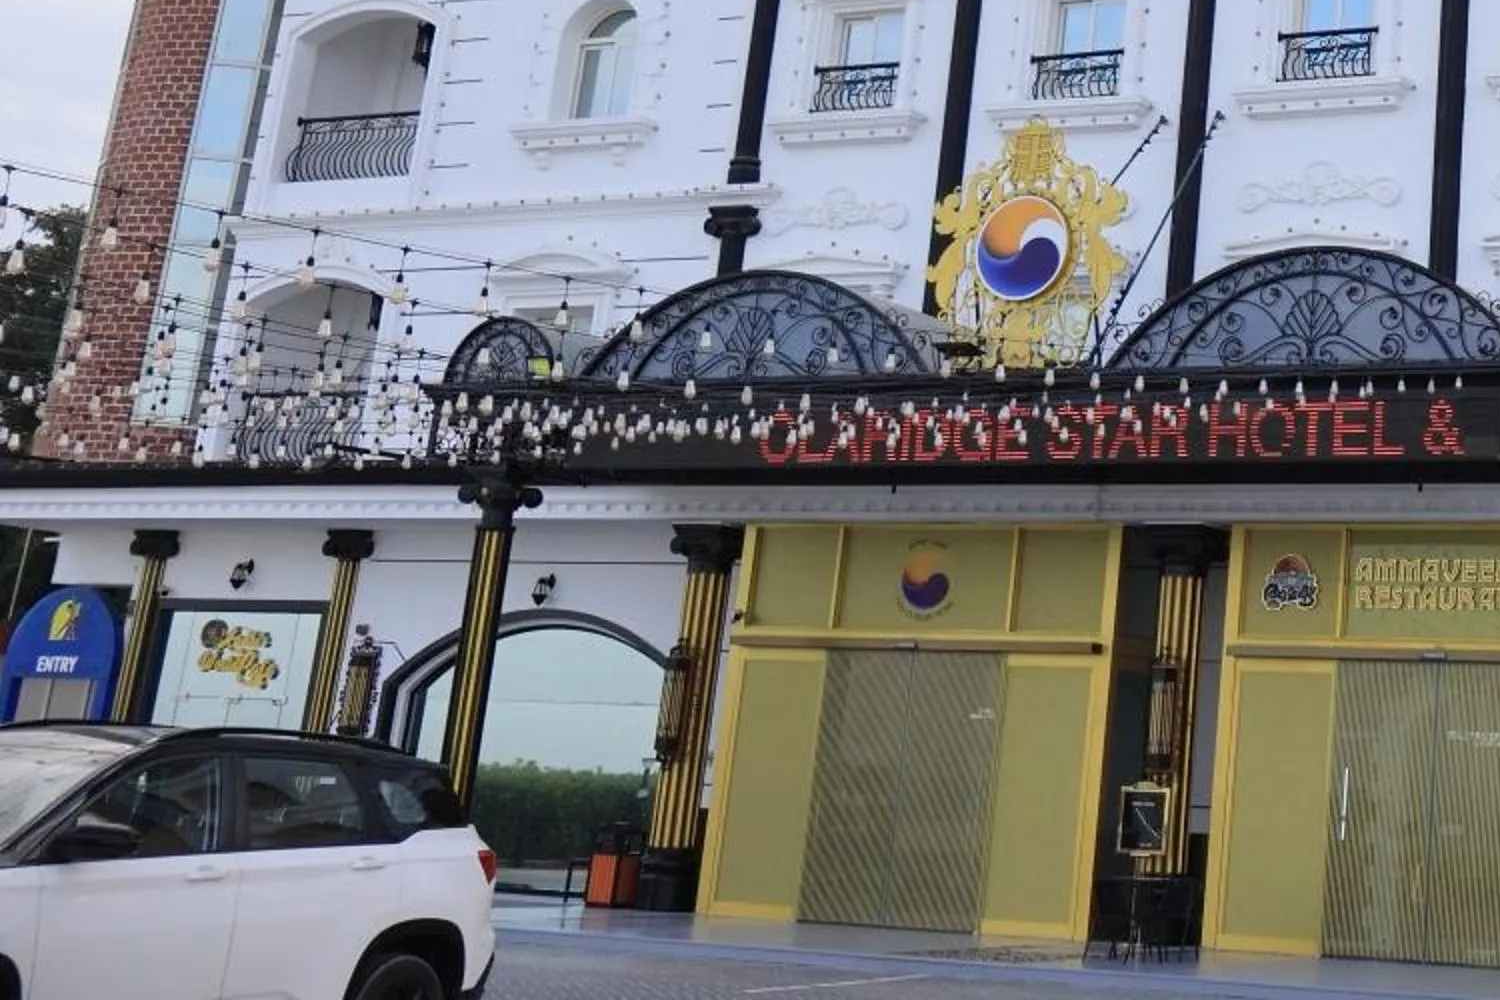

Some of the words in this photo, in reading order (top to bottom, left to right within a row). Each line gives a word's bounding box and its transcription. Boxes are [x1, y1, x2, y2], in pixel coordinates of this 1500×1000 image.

[758, 406, 1032, 464] CLARIDGE
[1047, 402, 1189, 459] STAR
[1207, 399, 1405, 457] HOTEL
[1423, 398, 1467, 456] &
[36, 655, 80, 673] ENTRY
